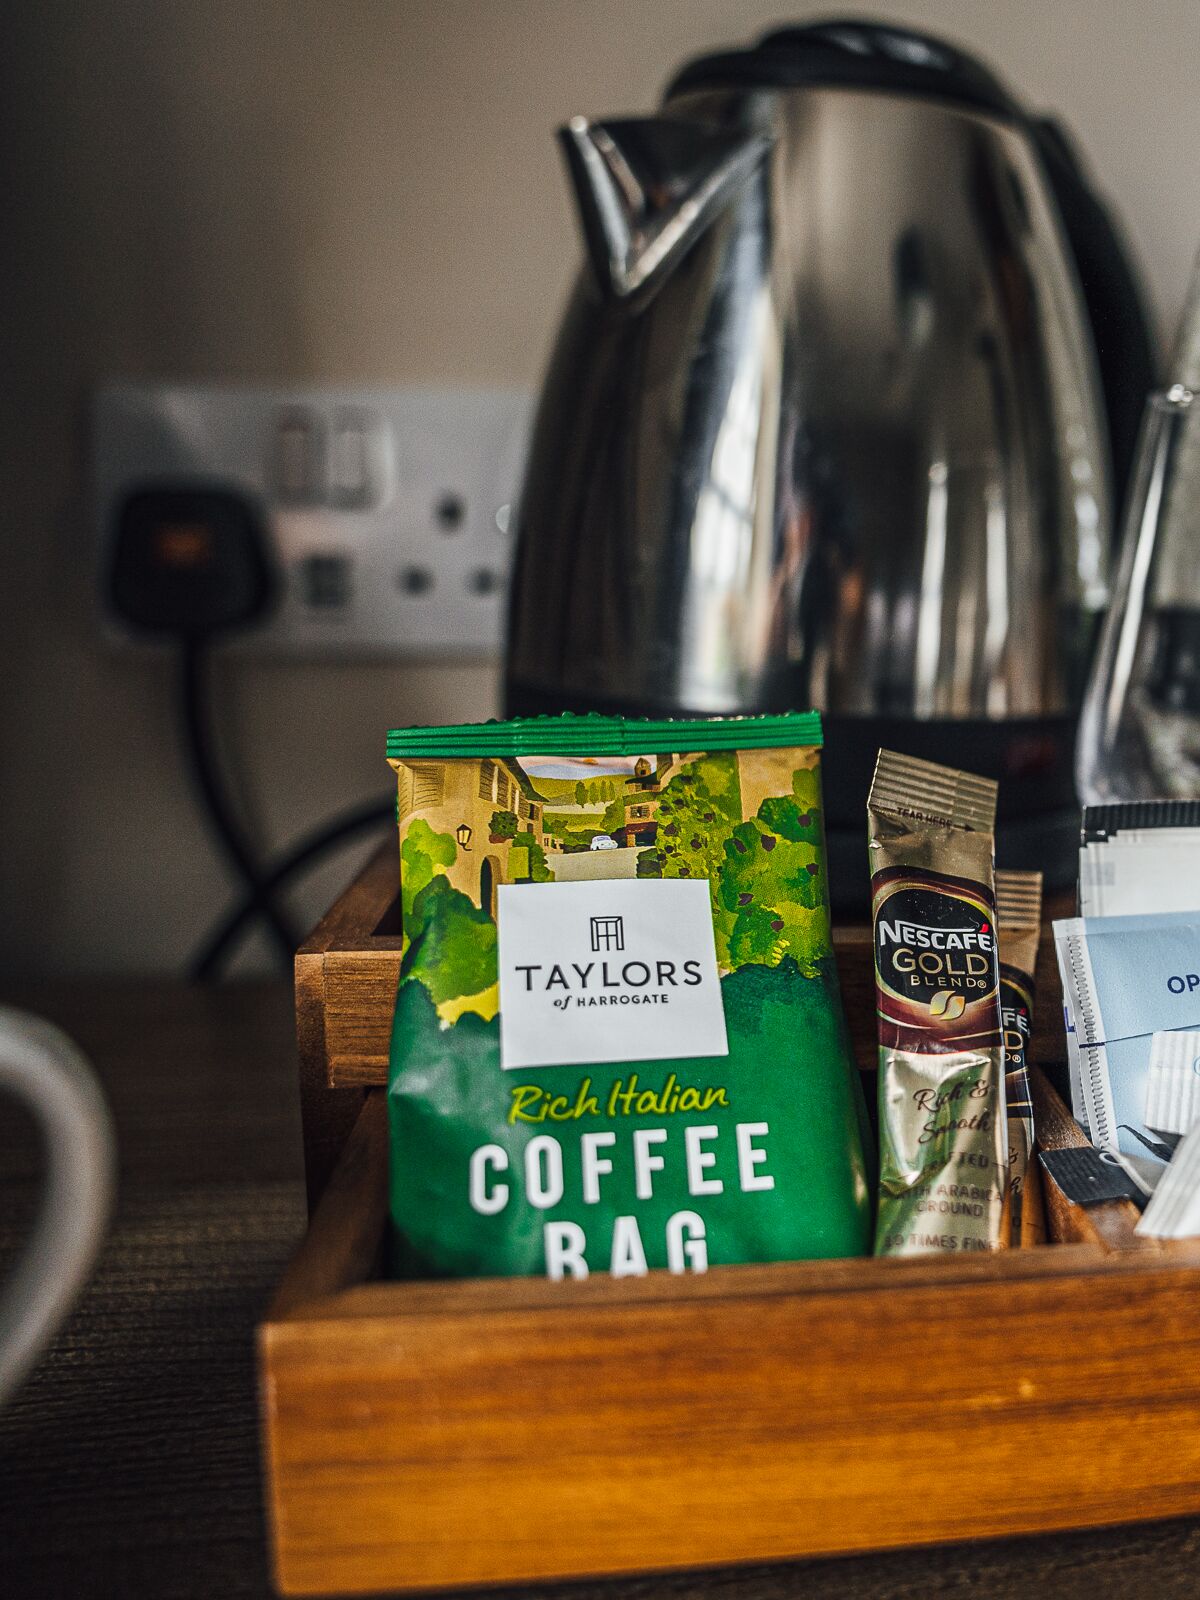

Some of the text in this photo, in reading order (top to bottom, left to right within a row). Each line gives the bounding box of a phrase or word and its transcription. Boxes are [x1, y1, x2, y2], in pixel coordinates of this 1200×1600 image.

[515, 960, 702, 991] TAYLORS
[892, 948, 989, 976] GOLD
[553, 994, 669, 1010] of HARROGATE
[508, 1073, 730, 1125] Rich Italian
[469, 1121, 775, 1216] COFFEE
[543, 1210, 709, 1282] BAG
